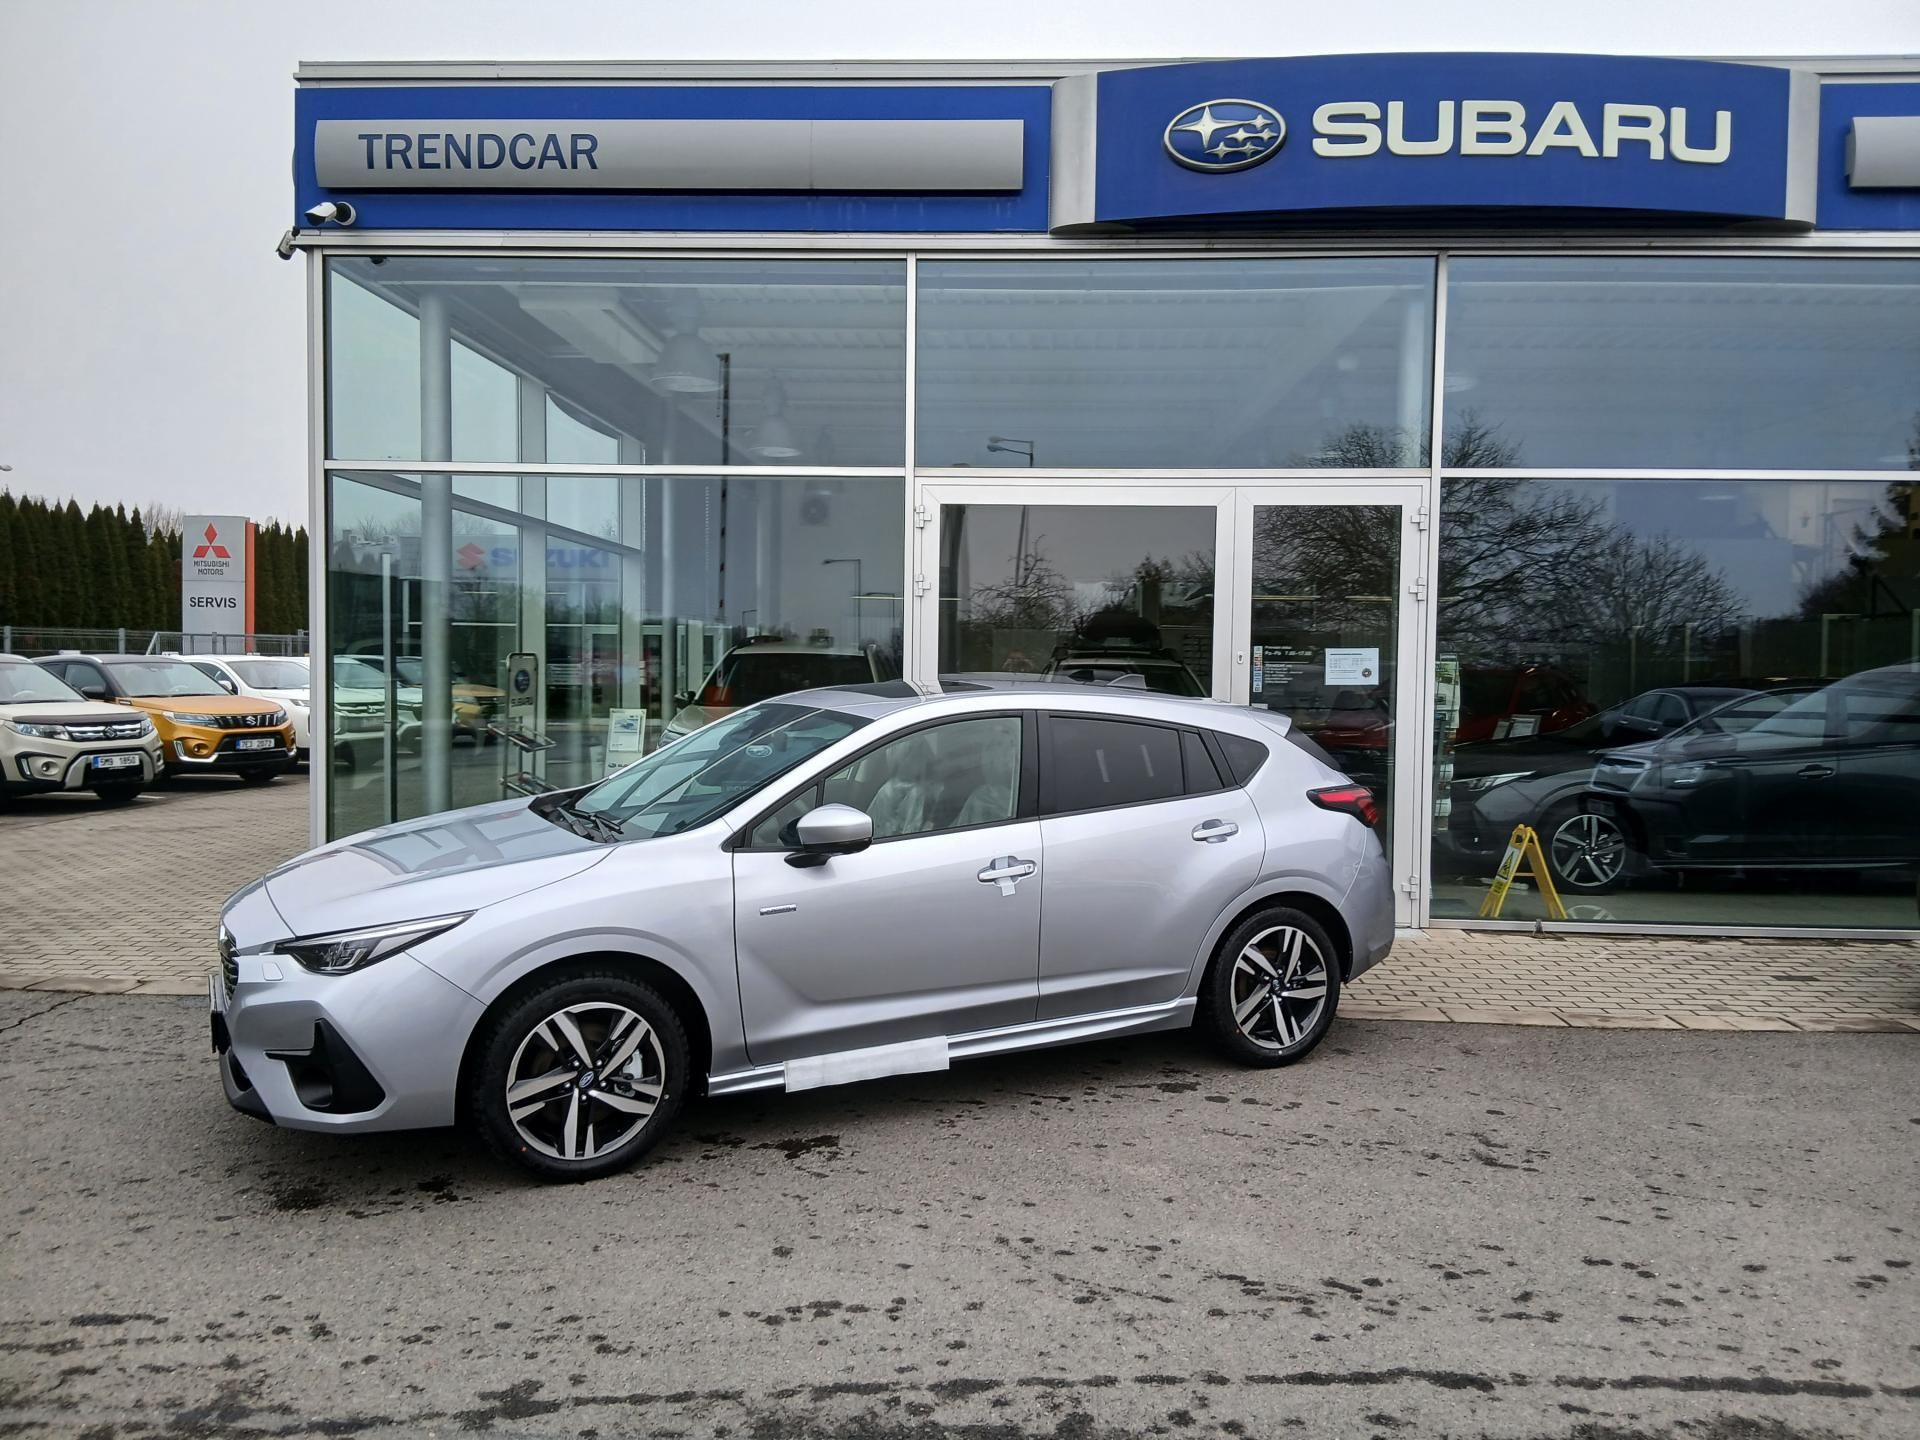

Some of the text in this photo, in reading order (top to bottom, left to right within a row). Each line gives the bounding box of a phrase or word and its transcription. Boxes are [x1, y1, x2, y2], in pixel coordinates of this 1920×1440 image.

[1311, 99, 1733, 165] SUBARU
[357, 133, 599, 170] TRENDCAR
[193, 560, 230, 568] MITSUBISHI
[490, 547, 609, 568] SZUKI
[197, 568, 224, 576] MOTORS
[189, 596, 237, 609] SERVIS
